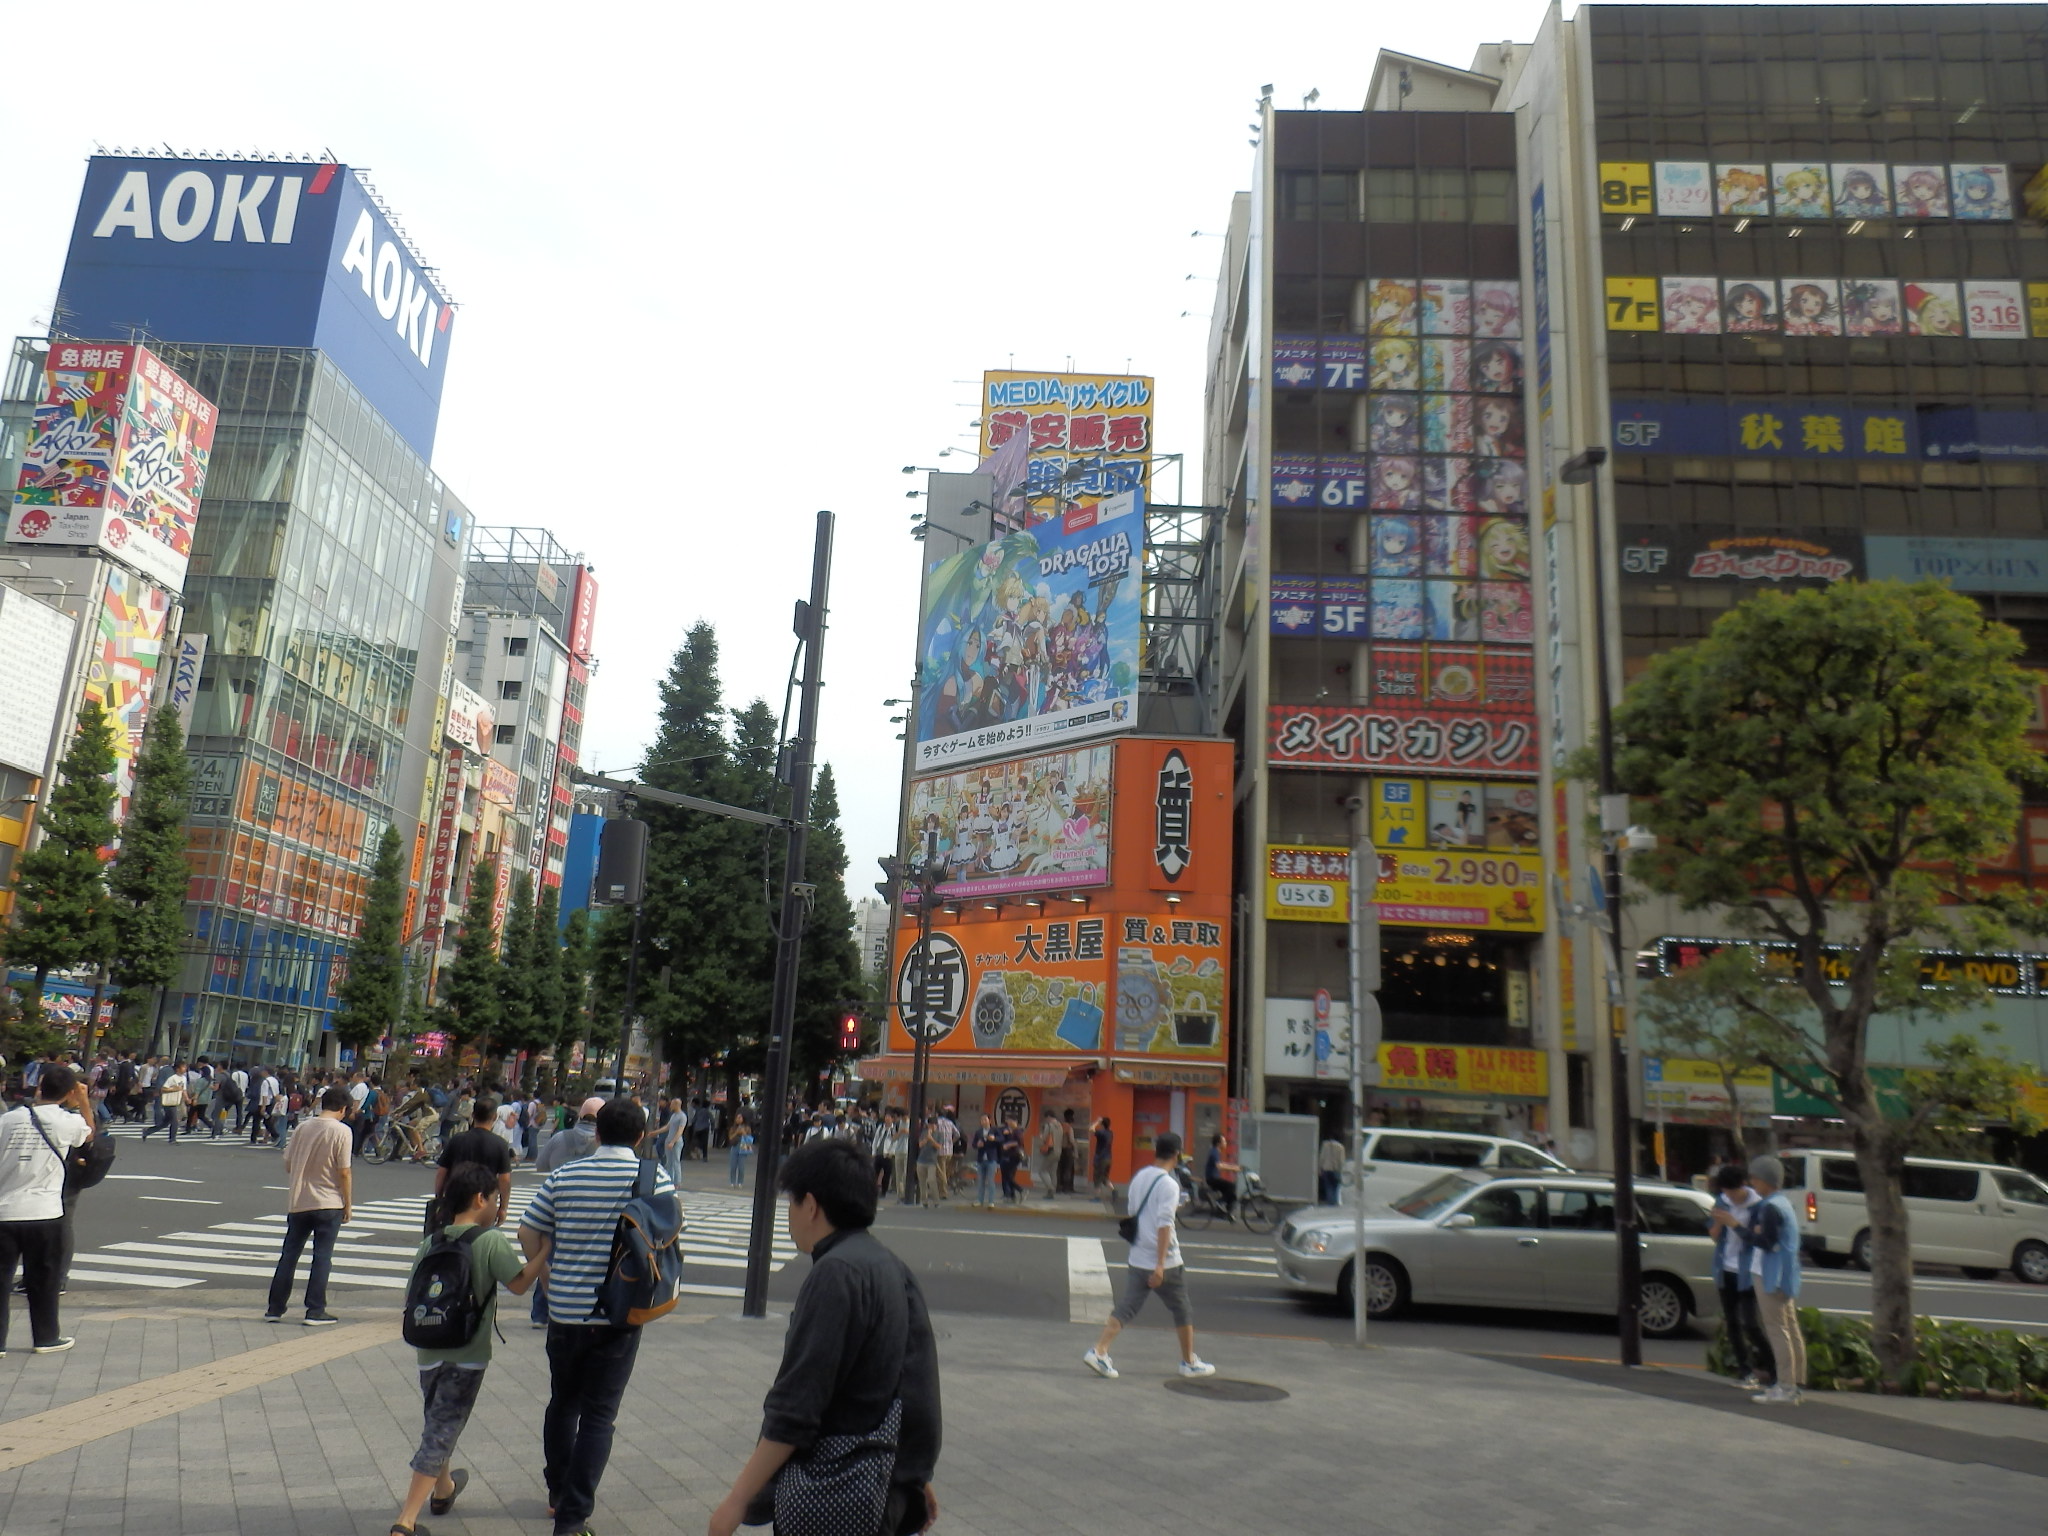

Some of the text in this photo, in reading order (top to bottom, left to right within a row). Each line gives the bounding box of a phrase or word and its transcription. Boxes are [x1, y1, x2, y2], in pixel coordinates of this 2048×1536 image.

[1602, 180, 1650, 207] 8F
[93, 171, 303, 244] AOKI
[342, 208, 438, 369] AOKI
[1609, 297, 1655, 324] 7F
[1970, 305, 2020, 324] 3.16
[59, 348, 124, 369] 免税店
[1325, 363, 1365, 388] 7F
[988, 378, 1151, 409] MEDIAリサイクル
[1616, 420, 1661, 447] 5F
[1740, 413, 1908, 454] 秋葉館
[1321, 479, 1365, 506] 6F
[1039, 531, 1132, 577] DRAGALIA
[1087, 550, 1132, 579] LOST
[1623, 547, 1669, 573] 5F
[1323, 605, 1366, 633] 5F
[1482, 610, 1532, 632] 3.16
[1377, 682, 1416, 695] Stars
[1277, 713, 1529, 766] メイドカジノ
[1387, 785, 1409, 800] 3F
[1155, 767, 1193, 867] 質
[1379, 808, 1416, 821] 入口
[1275, 853, 1392, 878] 全身もみし
[1281, 887, 1330, 903] りらくる
[1015, 918, 1106, 964] 大黒屋
[975, 951, 1010, 968] チケット
[1963, 960, 2017, 986] DVD
[1467, 1048, 1537, 1073] TAX FREE
